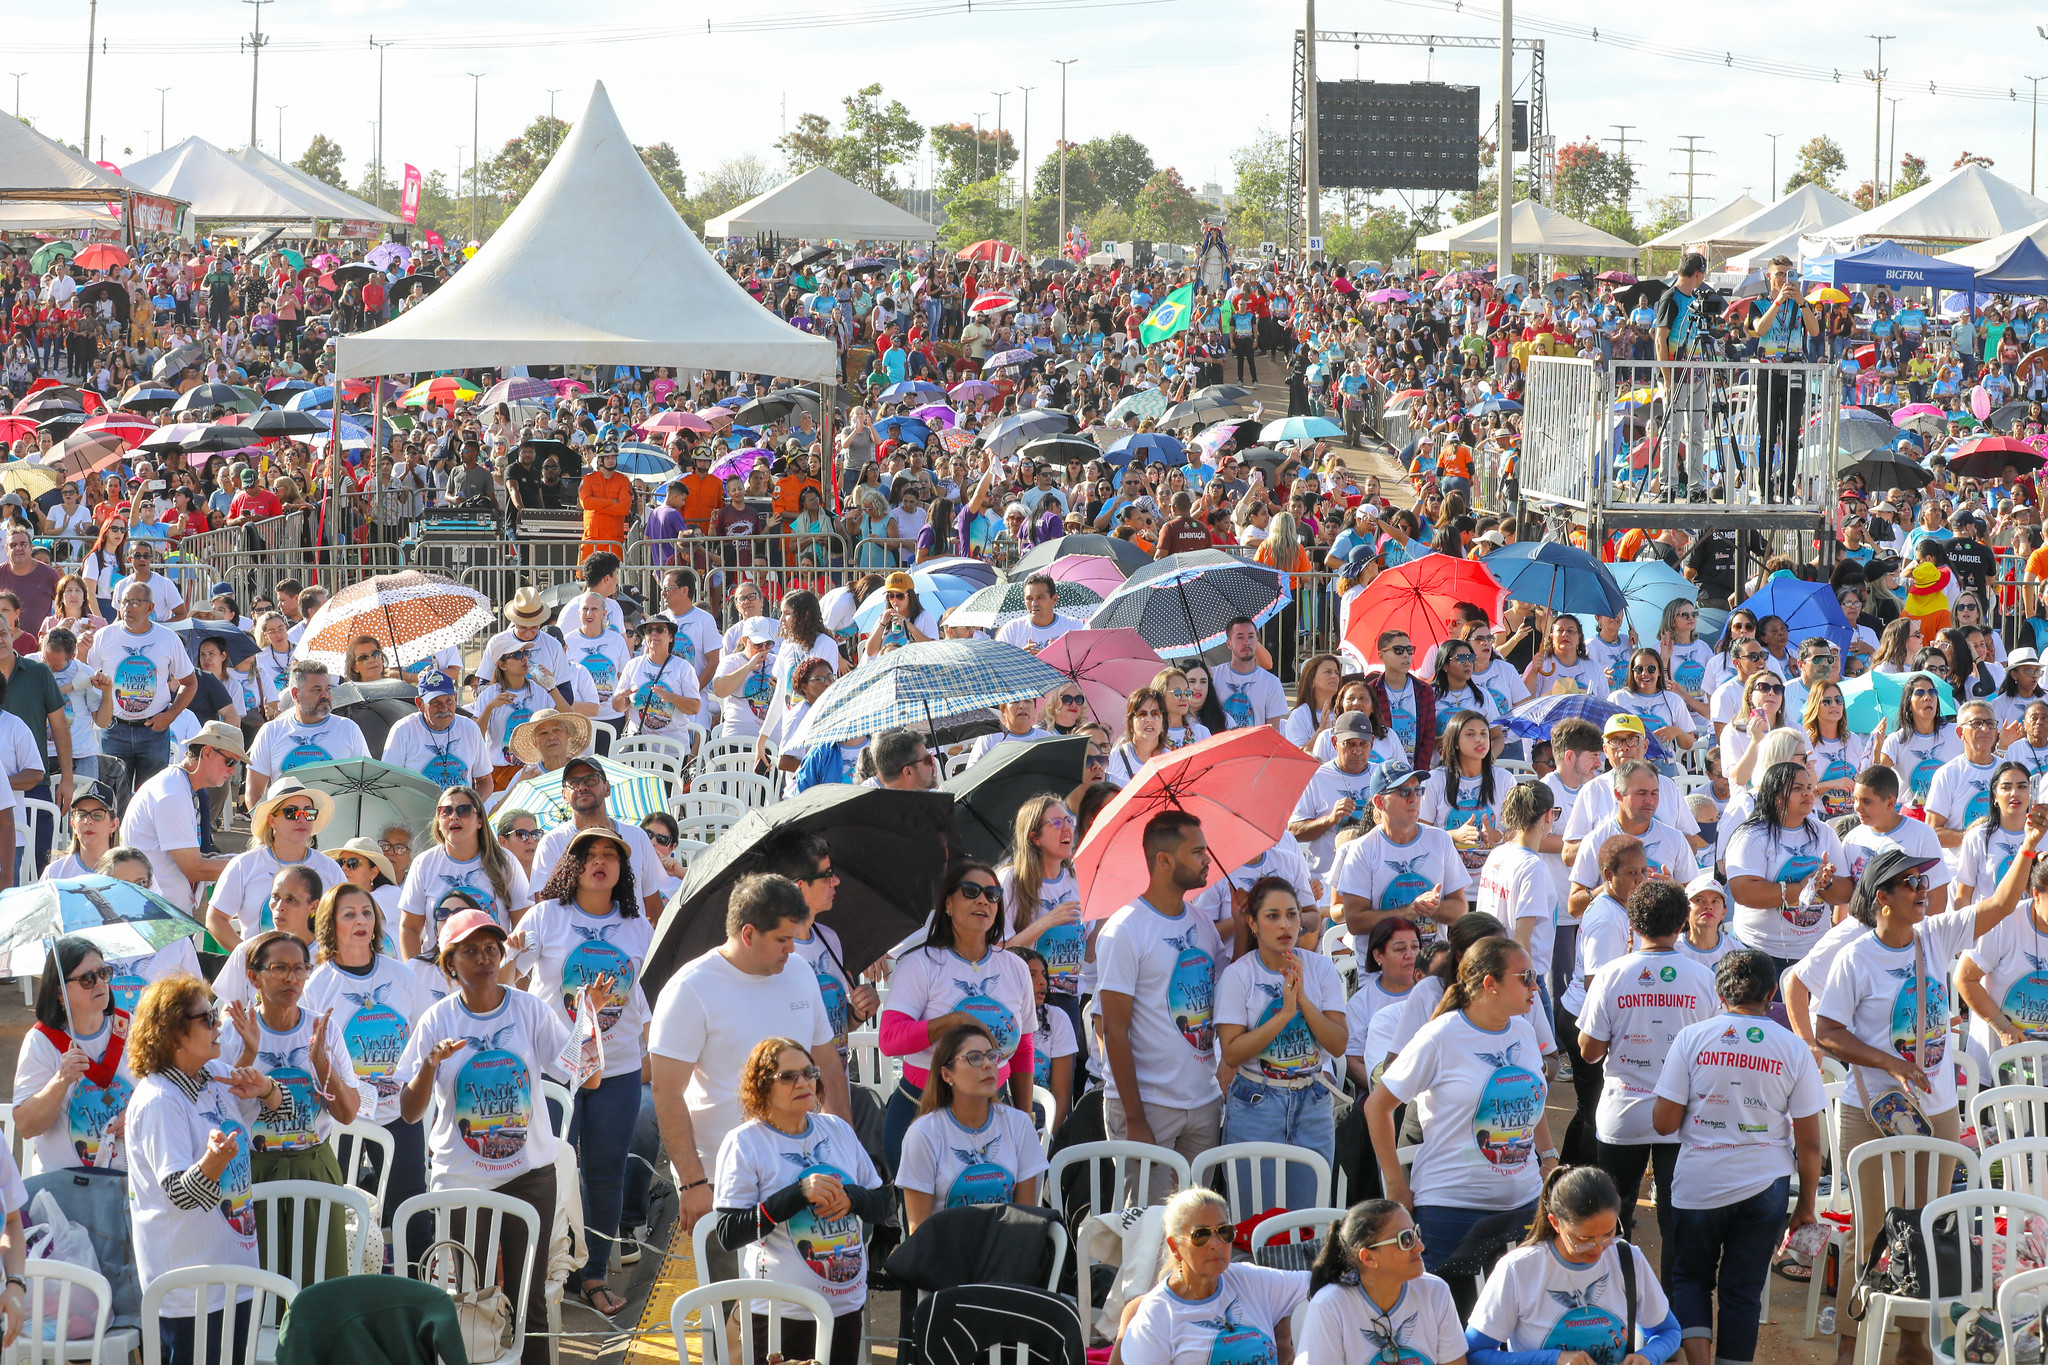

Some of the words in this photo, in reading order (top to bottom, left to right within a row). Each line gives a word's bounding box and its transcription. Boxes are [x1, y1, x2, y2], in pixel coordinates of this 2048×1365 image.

[1105, 243, 1115, 253] C1
[1263, 244, 1273, 252] B2
[1311, 240, 1320, 248] B1
[1886, 270, 1924, 280] BIGFRAL
[1179, 531, 1206, 540] ALIMENTAÇÃO
[1947, 552, 1957, 561] ÃO
[1959, 555, 1981, 563] MIGUEL
[582, 947, 618, 956] PENTECOSTES
[1045, 938, 1082, 953] VINDE
[964, 1003, 1001, 1012] PENTECOSTES
[1618, 994, 1696, 1009] CONTRIBUINTE
[357, 1013, 396, 1023] PENTECOSTES
[352, 1033, 400, 1051] VINDE
[362, 1050, 400, 1064] VEDE
[1697, 1051, 1783, 1075] CONTRIBUINTE
[472, 1058, 514, 1070] PENTECOSTES
[1495, 1074, 1530, 1086] PENTECOSTES
[465, 1081, 518, 1102] VINDE
[472, 1106, 477, 1114] E
[477, 1099, 522, 1116] VEDE
[1490, 1096, 1534, 1114] VINDE
[1744, 1097, 1768, 1107] DONA
[1492, 1117, 1497, 1126] E
[1497, 1112, 1534, 1128] VEDE
[476, 1158, 522, 1172] CONTRIBUINTE
[964, 1172, 1004, 1184] PENTECOSTES
[810, 1226, 817, 1234] E
[816, 1216, 857, 1235] VEDE
[1565, 1317, 1609, 1330] PENTECOSTES
